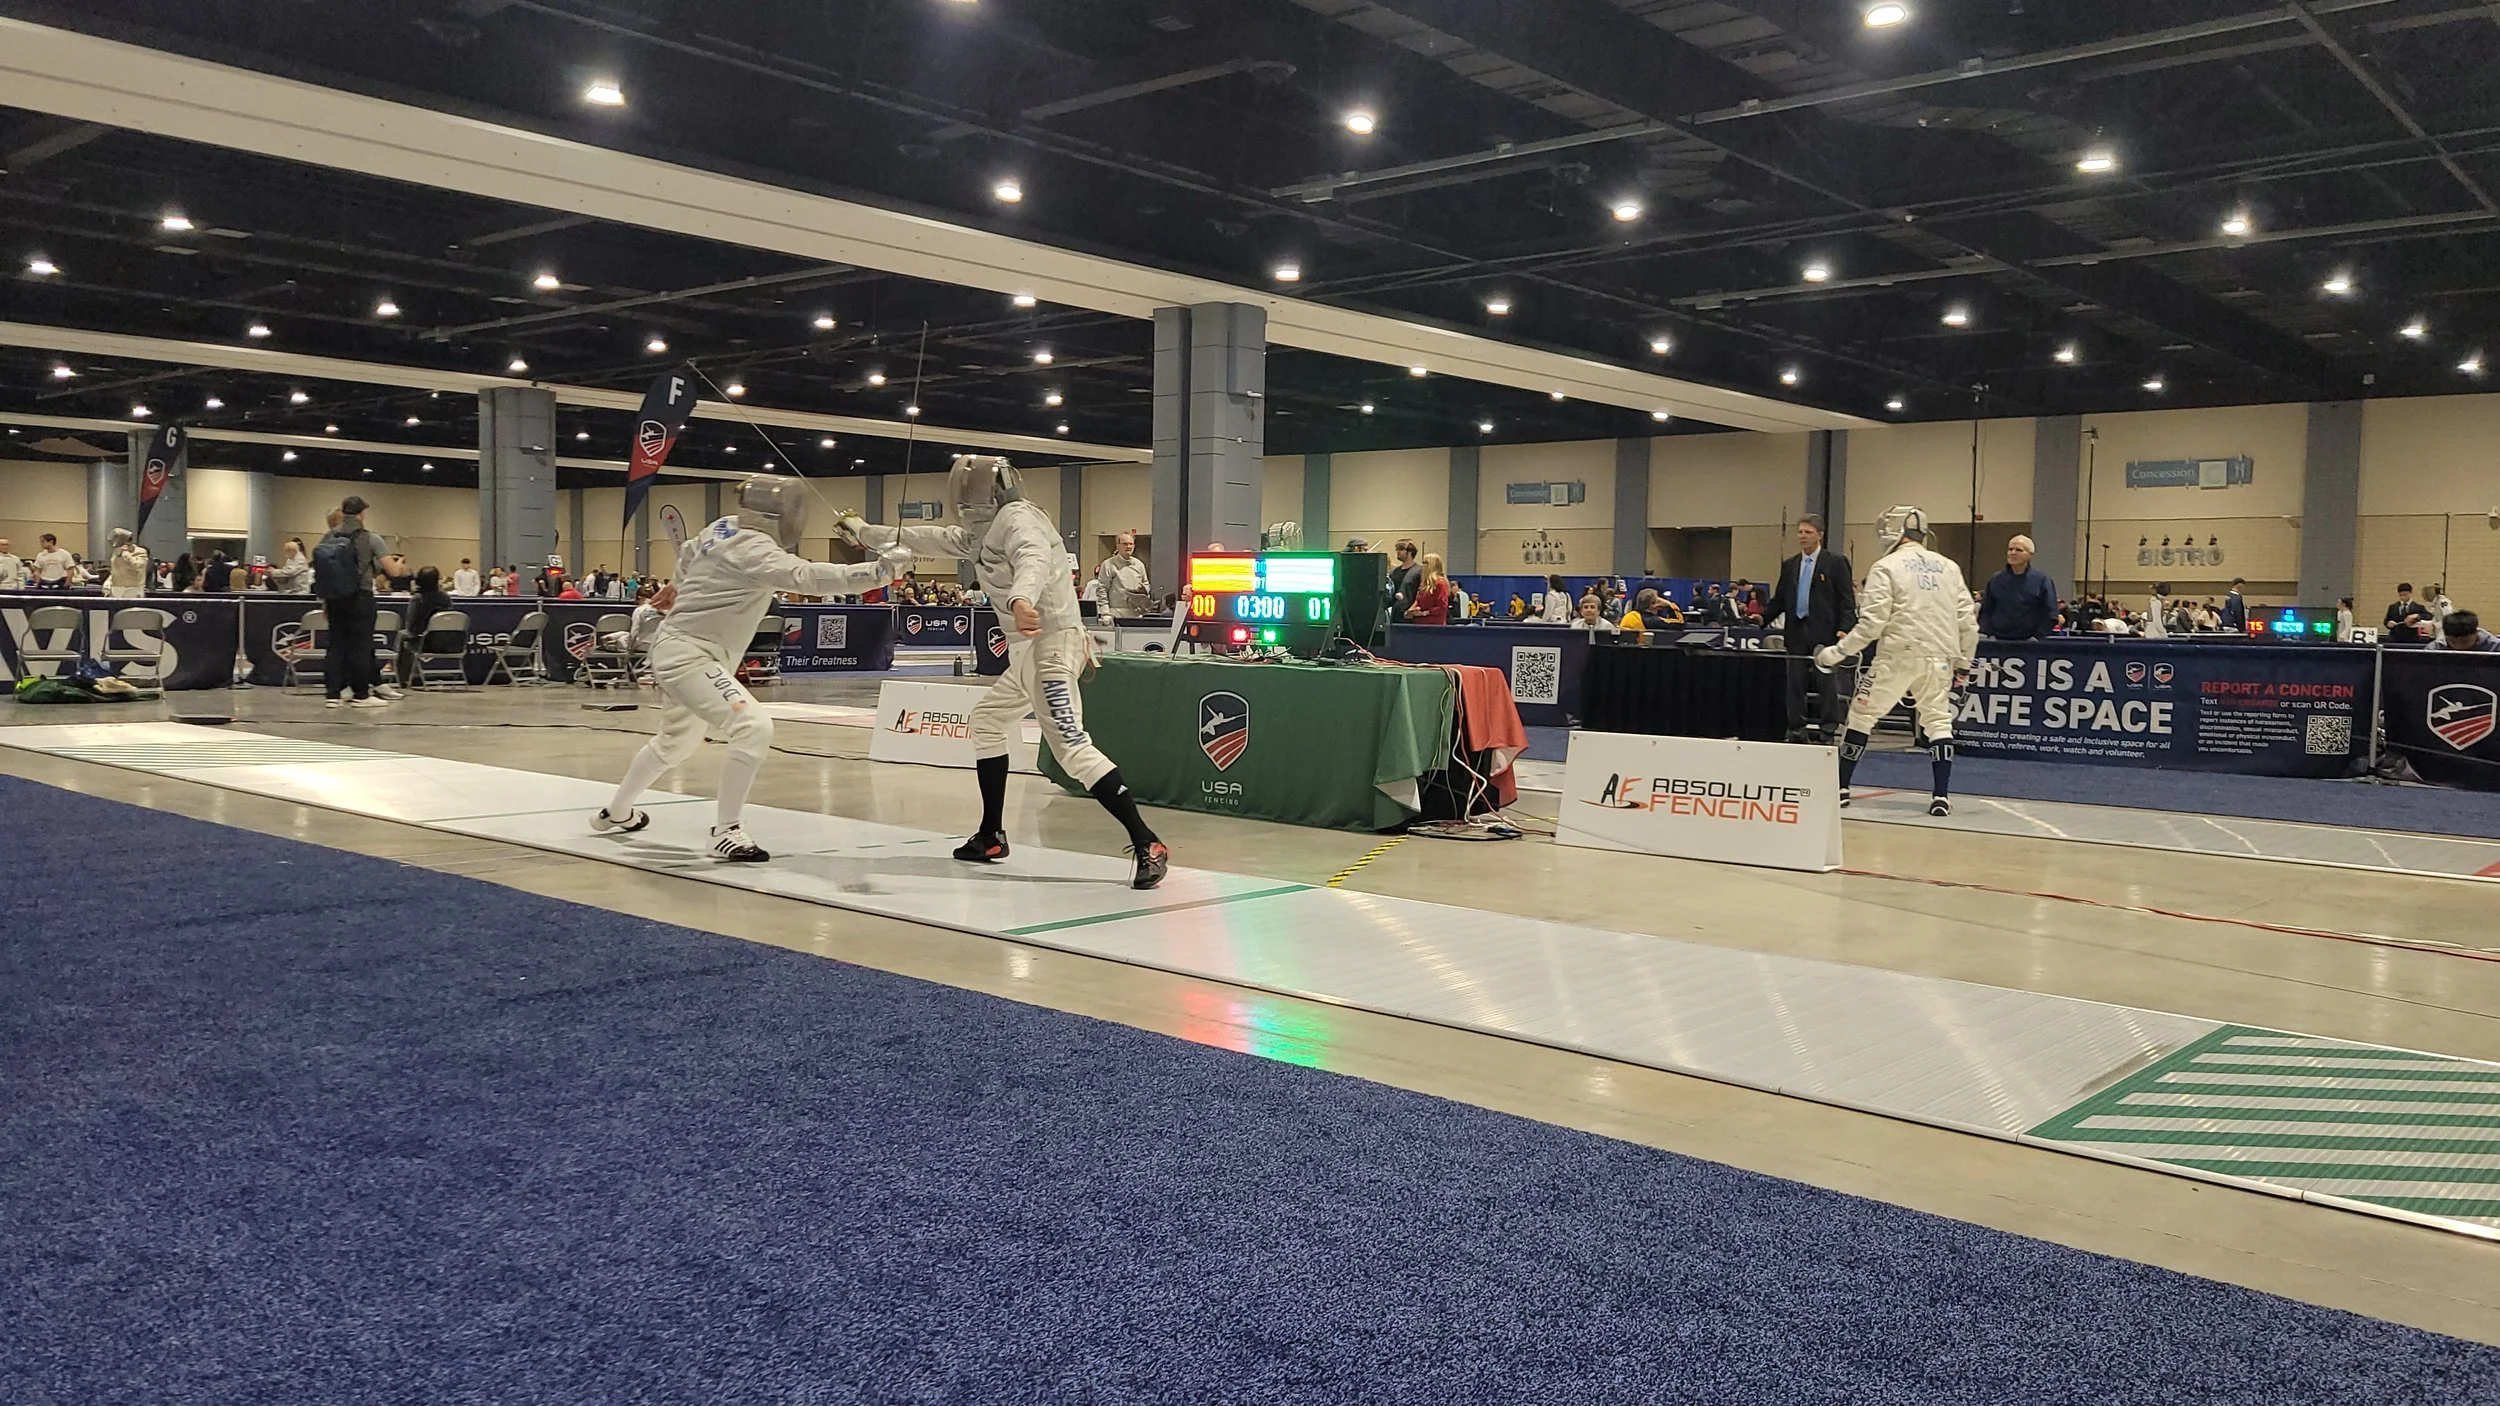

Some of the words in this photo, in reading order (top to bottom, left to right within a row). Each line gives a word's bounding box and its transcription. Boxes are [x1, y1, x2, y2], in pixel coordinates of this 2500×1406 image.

[668, 376, 685, 405] F
[166, 426, 178, 447] G
[2131, 467, 2195, 480] Concession
[2137, 547, 2225, 567] BISTRO
[1916, 573, 1940, 590] USA
[1192, 594, 1216, 617] 00
[1308, 597, 1331, 620] 01
[925, 619, 948, 627] USA
[785, 656, 810, 666] Their
[811, 655, 858, 666] Greatness
[2037, 659, 2074, 691] IS
[2083, 661, 2114, 693] A
[2201, 681, 2261, 694] REPORT
[2264, 683, 2275, 695] A
[2278, 684, 2355, 697] CONCERN
[2200, 697, 2218, 705] Text
[2313, 701, 2327, 709] QR
[2328, 701, 2353, 710] Code.
[921, 711, 971, 725] ABSOL
[1041, 680, 1088, 748] ANDERSON
[2042, 697, 2174, 735] SPACE
[919, 722, 972, 739] FENCI
[1959, 730, 1999, 738] committed
[2009, 733, 2041, 742] creating
[2049, 734, 2066, 743] safe
[2067, 736, 2082, 744] and
[2146, 740, 2158, 748] for
[2159, 741, 2171, 749] all
[1982, 741, 2005, 749] coach,
[2008, 742, 2037, 751] referee,
[2063, 746, 2087, 754] watch
[2088, 747, 2104, 755] and
[2105, 748, 2145, 758] volunteer.
[1201, 780, 1243, 795] USA
[1204, 795, 1239, 806] FENCING
[1649, 794, 1799, 825] FENCING
